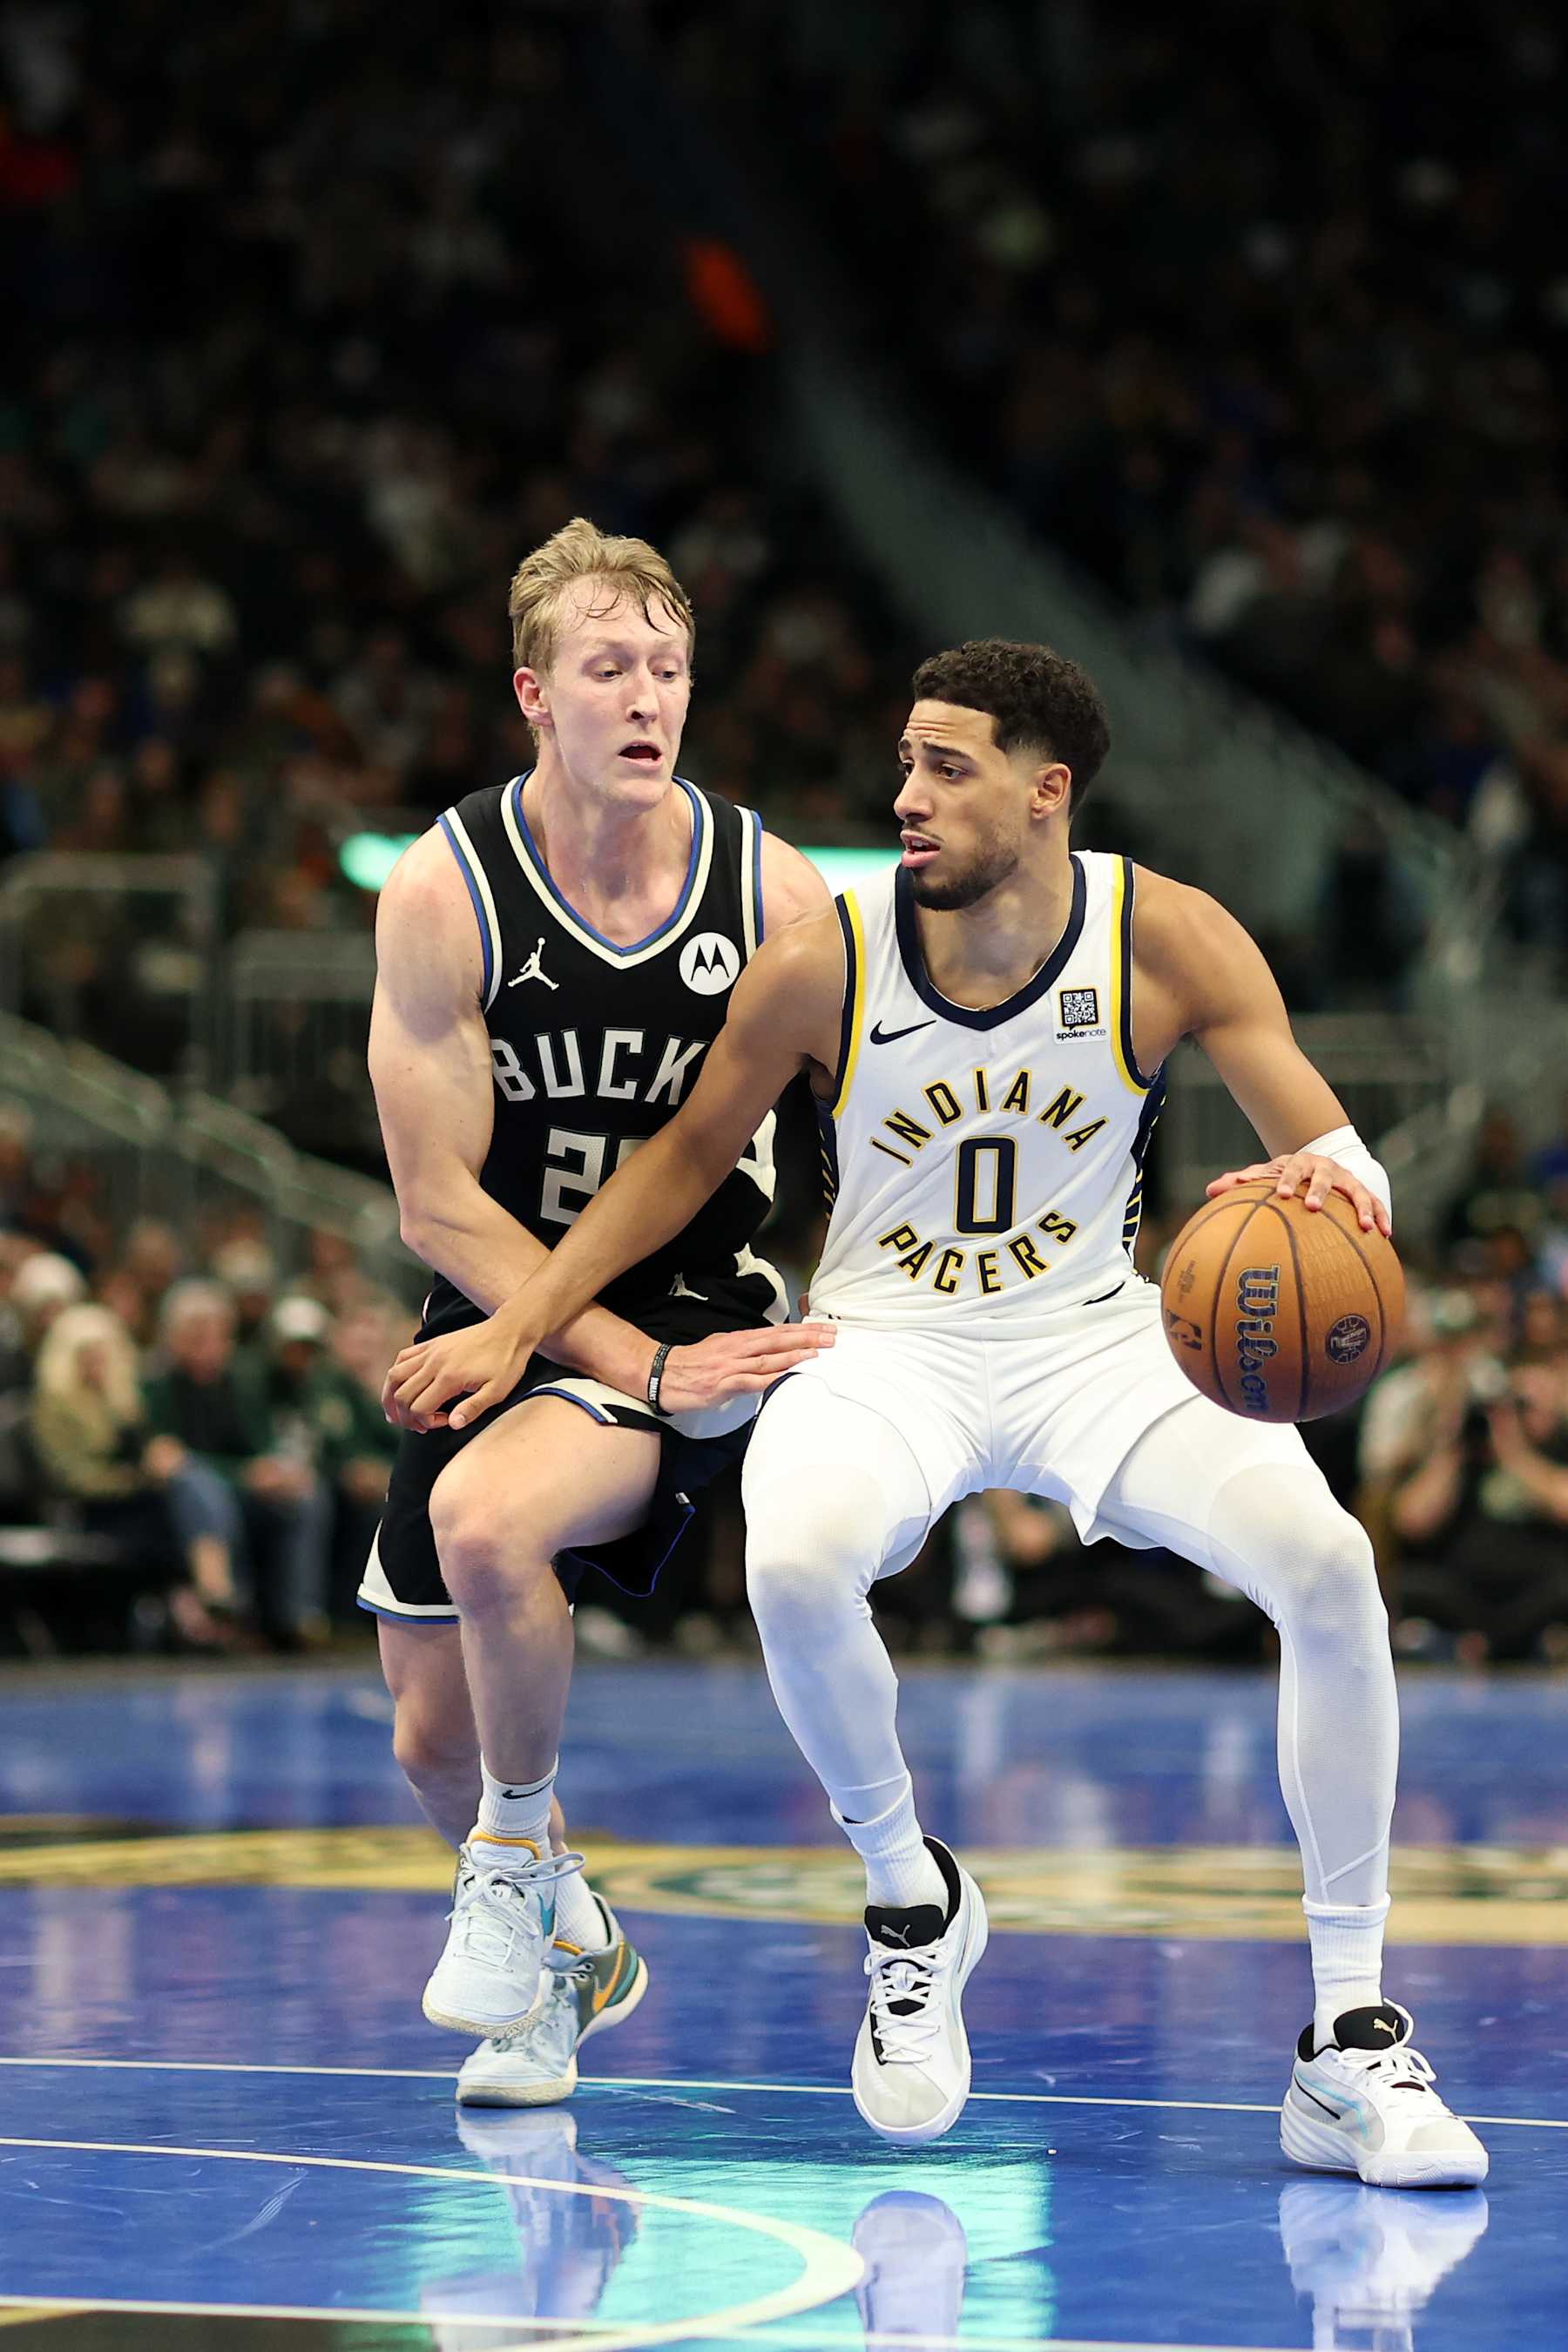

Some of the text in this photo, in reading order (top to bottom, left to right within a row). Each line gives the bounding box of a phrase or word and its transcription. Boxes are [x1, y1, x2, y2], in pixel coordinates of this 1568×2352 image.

[491, 1027, 711, 1105] BUCK
[1056, 1028, 1106, 1041] spokenote
[869, 1066, 1110, 1168] INDIANA
[540, 1125, 653, 1226] 2
[954, 1134, 1018, 1237] 0
[878, 1210, 1078, 1296] PACERS
[1235, 1263, 1281, 1412] Wilson
